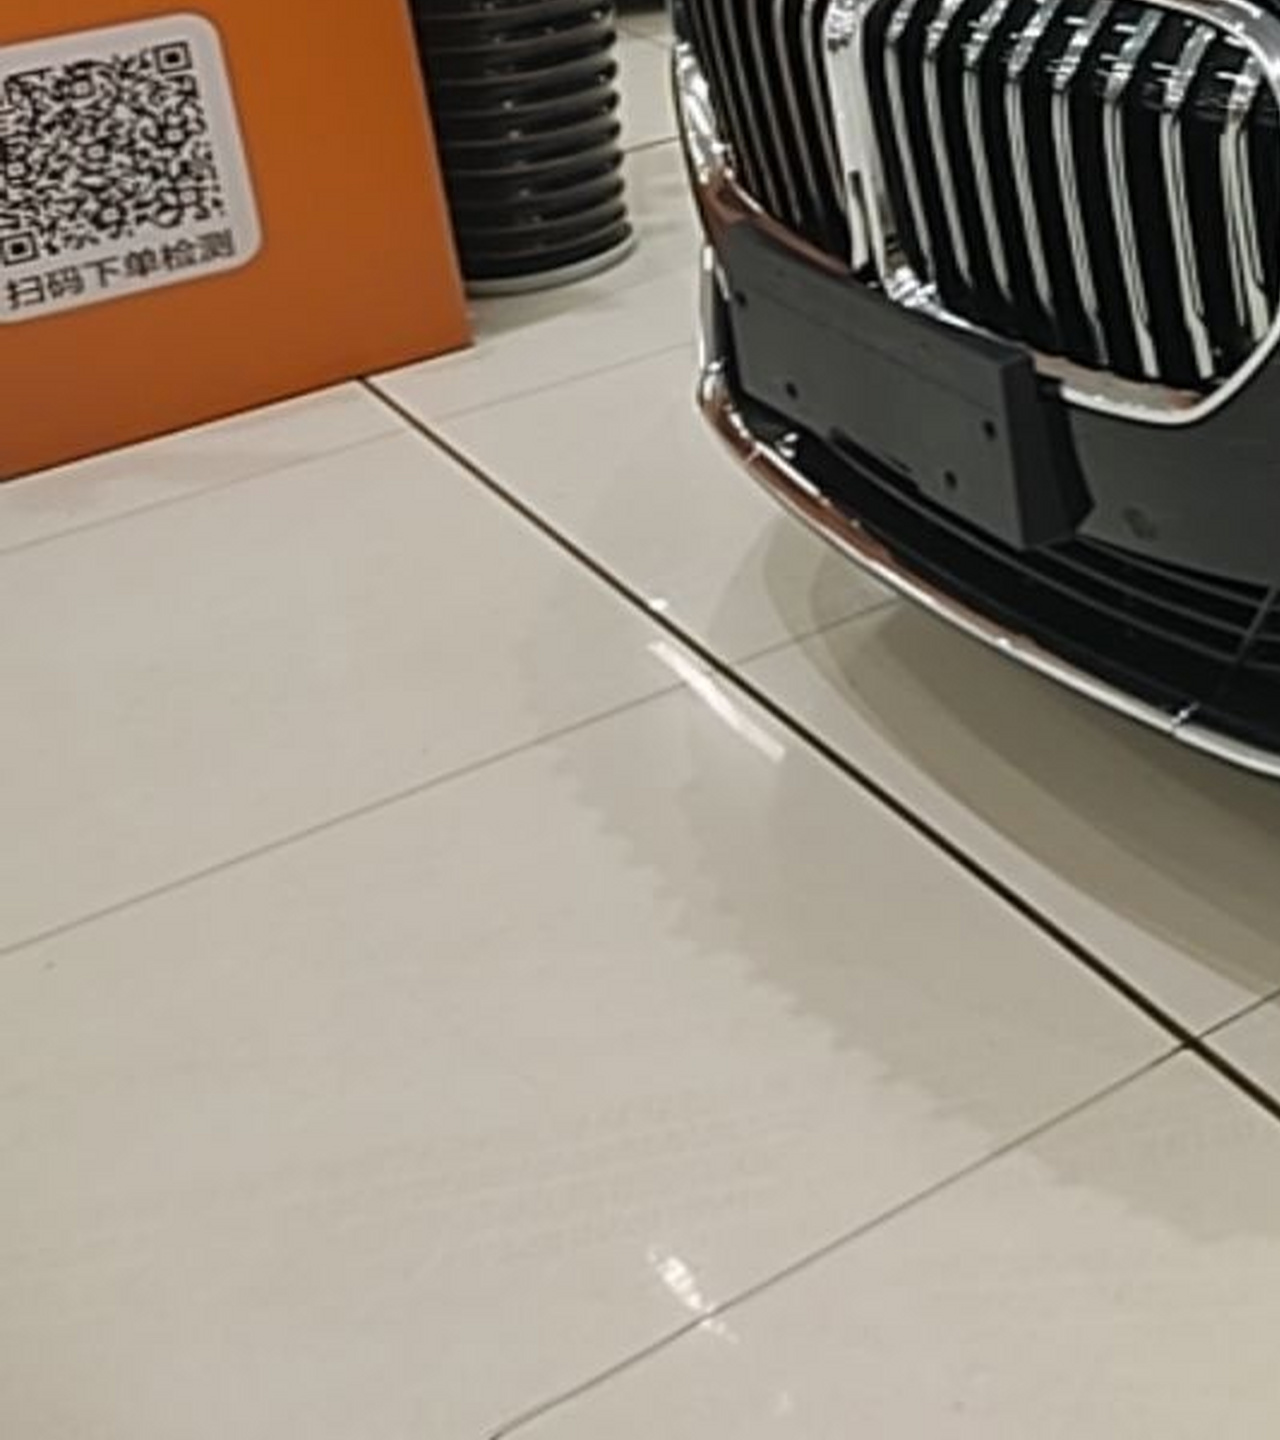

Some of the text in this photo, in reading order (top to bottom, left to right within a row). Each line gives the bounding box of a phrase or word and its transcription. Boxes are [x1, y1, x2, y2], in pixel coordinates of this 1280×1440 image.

[6, 229, 236, 310] 扫码下单检测
